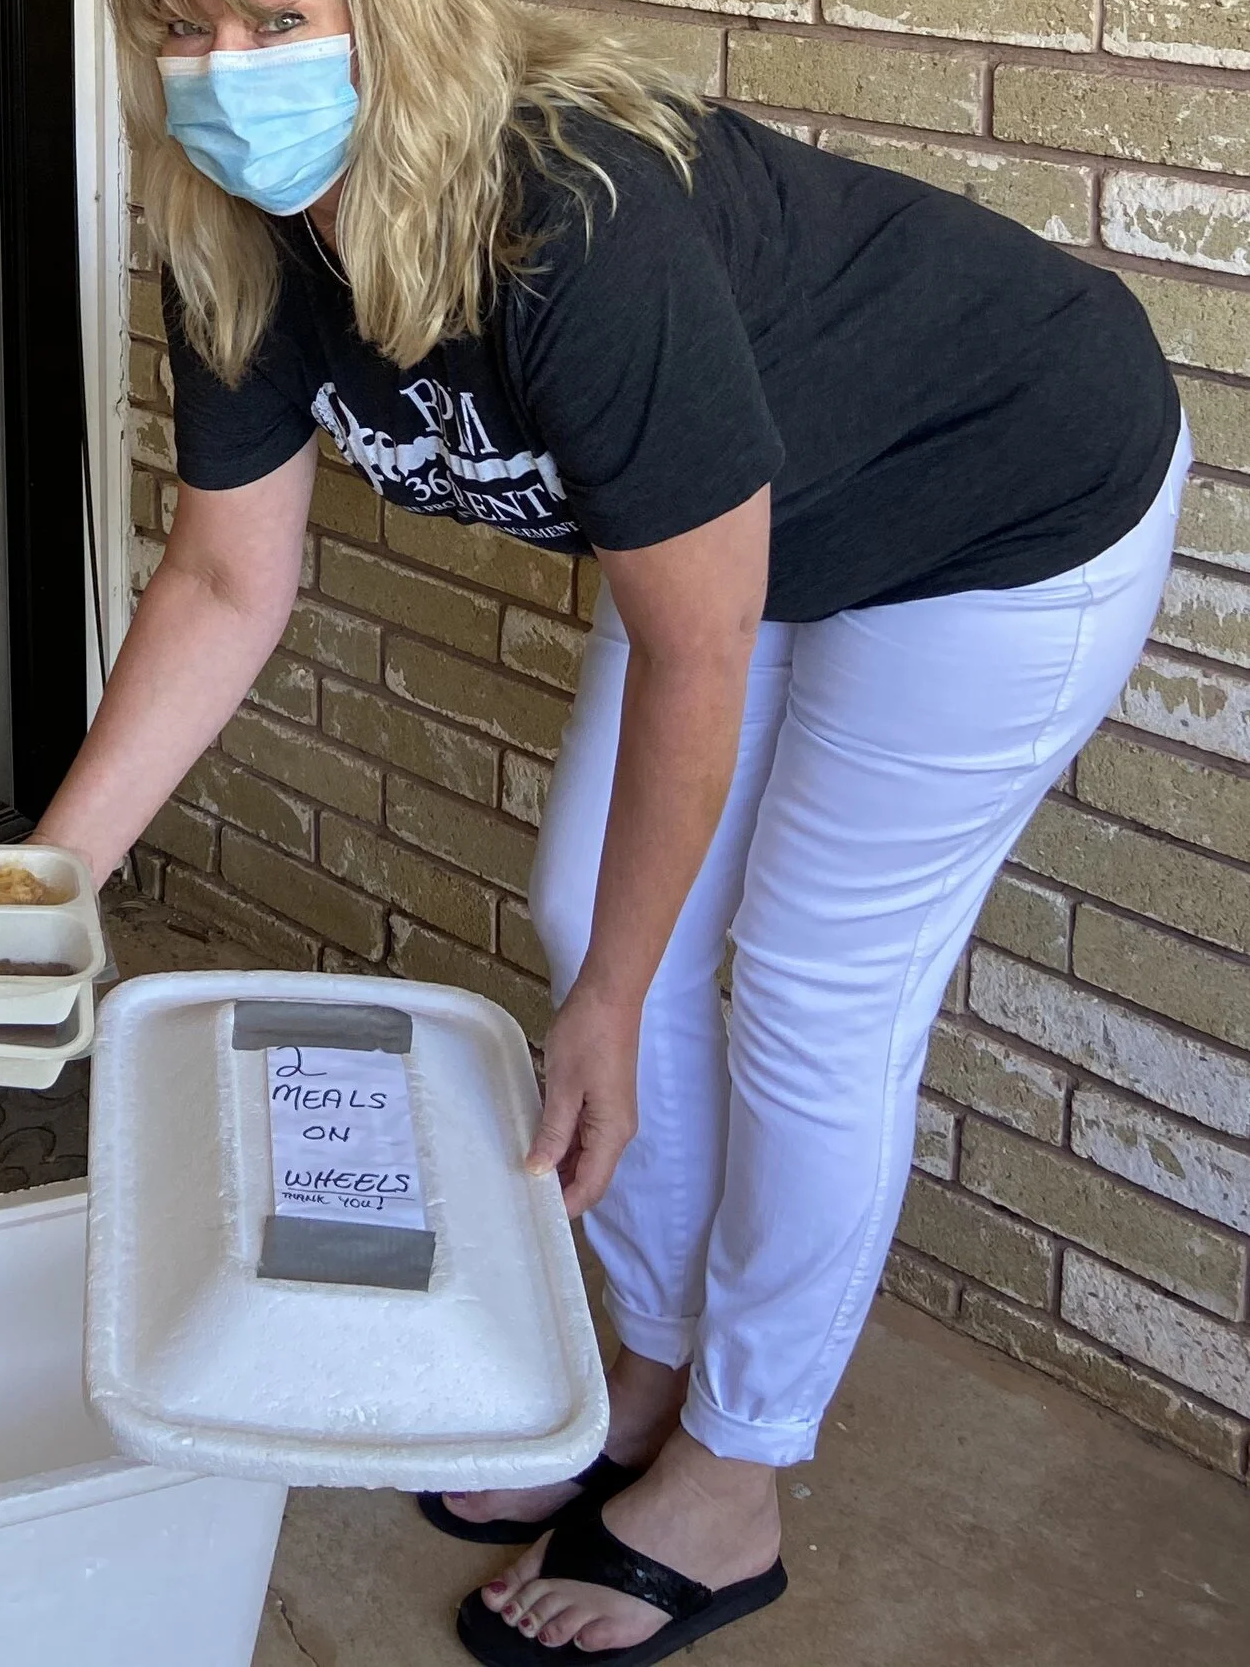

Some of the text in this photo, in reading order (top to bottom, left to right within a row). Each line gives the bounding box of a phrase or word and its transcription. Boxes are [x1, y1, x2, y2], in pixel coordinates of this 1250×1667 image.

[405, 467, 453, 502] 36
[275, 1046, 327, 1077] 2
[272, 1084, 387, 1111] MEALS
[303, 1126, 350, 1142] ON
[284, 1169, 410, 1193] WHEELS
[282, 1192, 331, 1205] THANK
